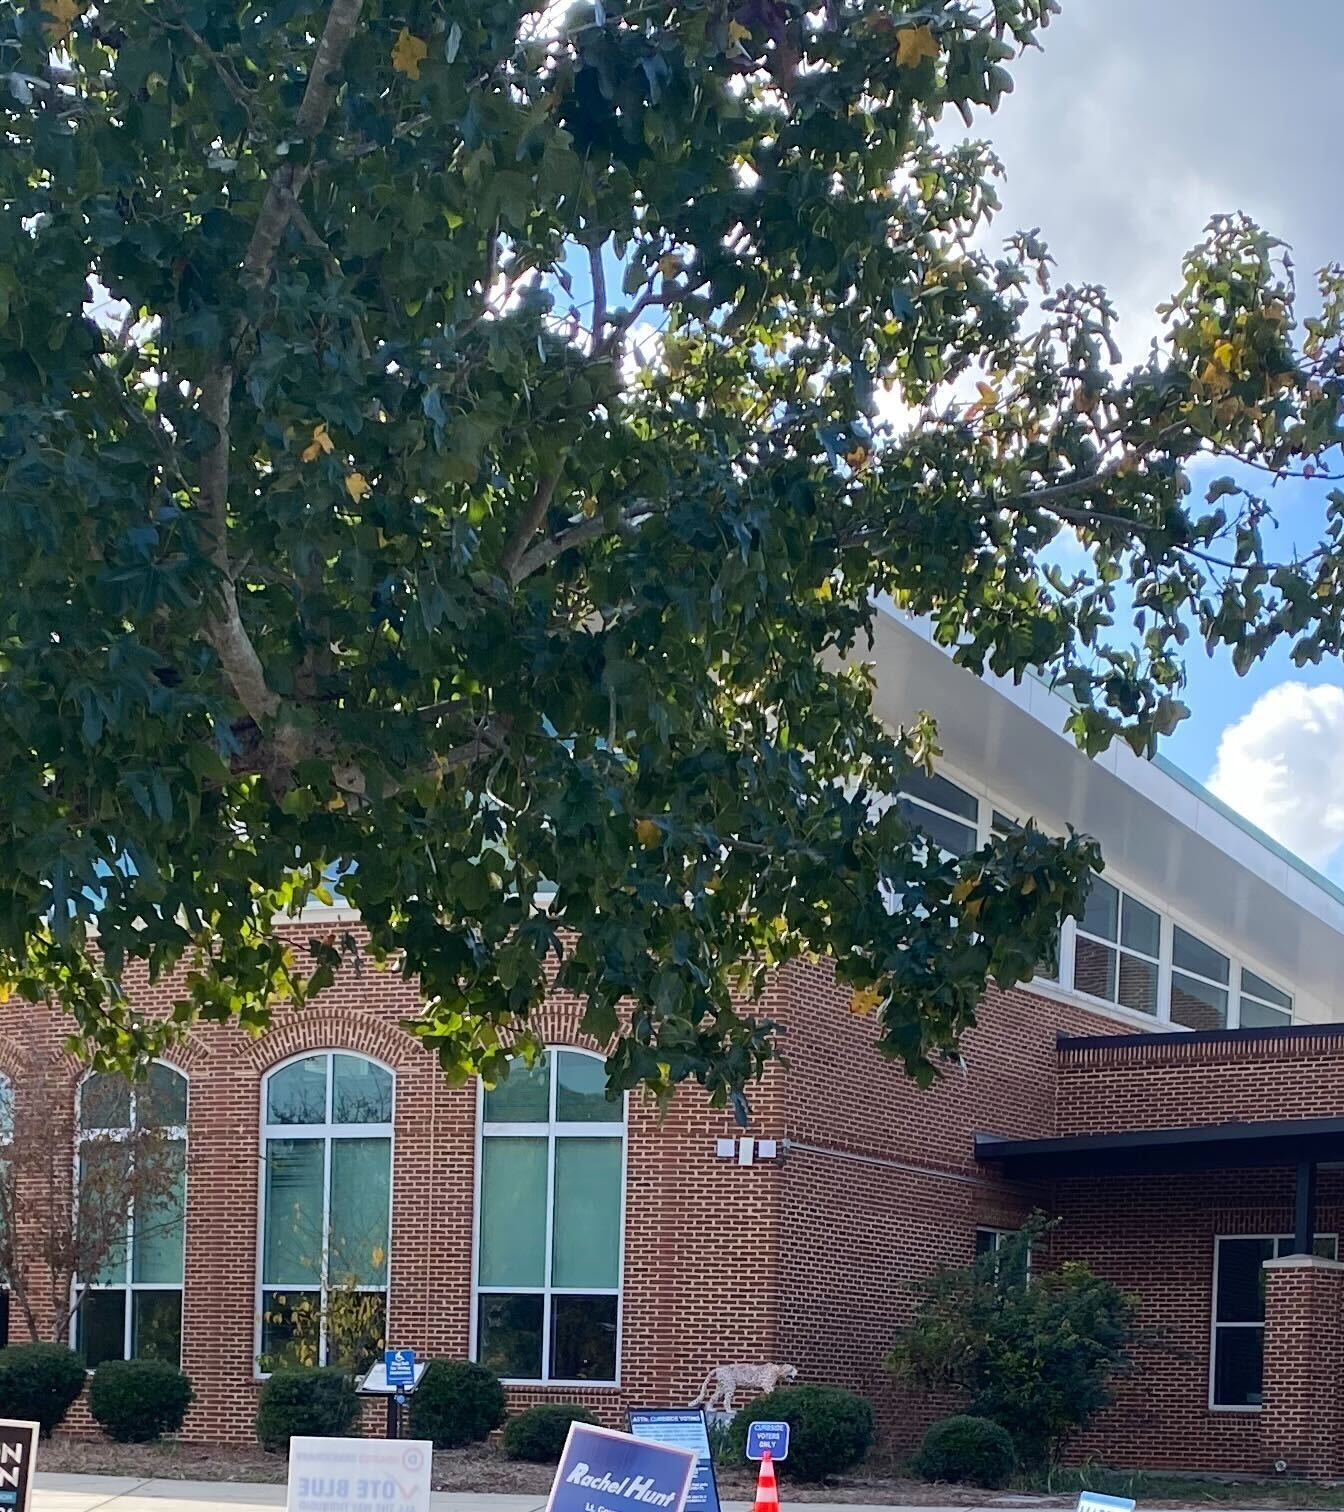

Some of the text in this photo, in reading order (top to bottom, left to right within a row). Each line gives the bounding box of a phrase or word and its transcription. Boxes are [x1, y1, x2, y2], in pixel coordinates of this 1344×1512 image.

[566, 1462, 630, 1495] Rachel
[623, 1475, 676, 1507] Hunt
[585, 1502, 596, 1512] Lt.
